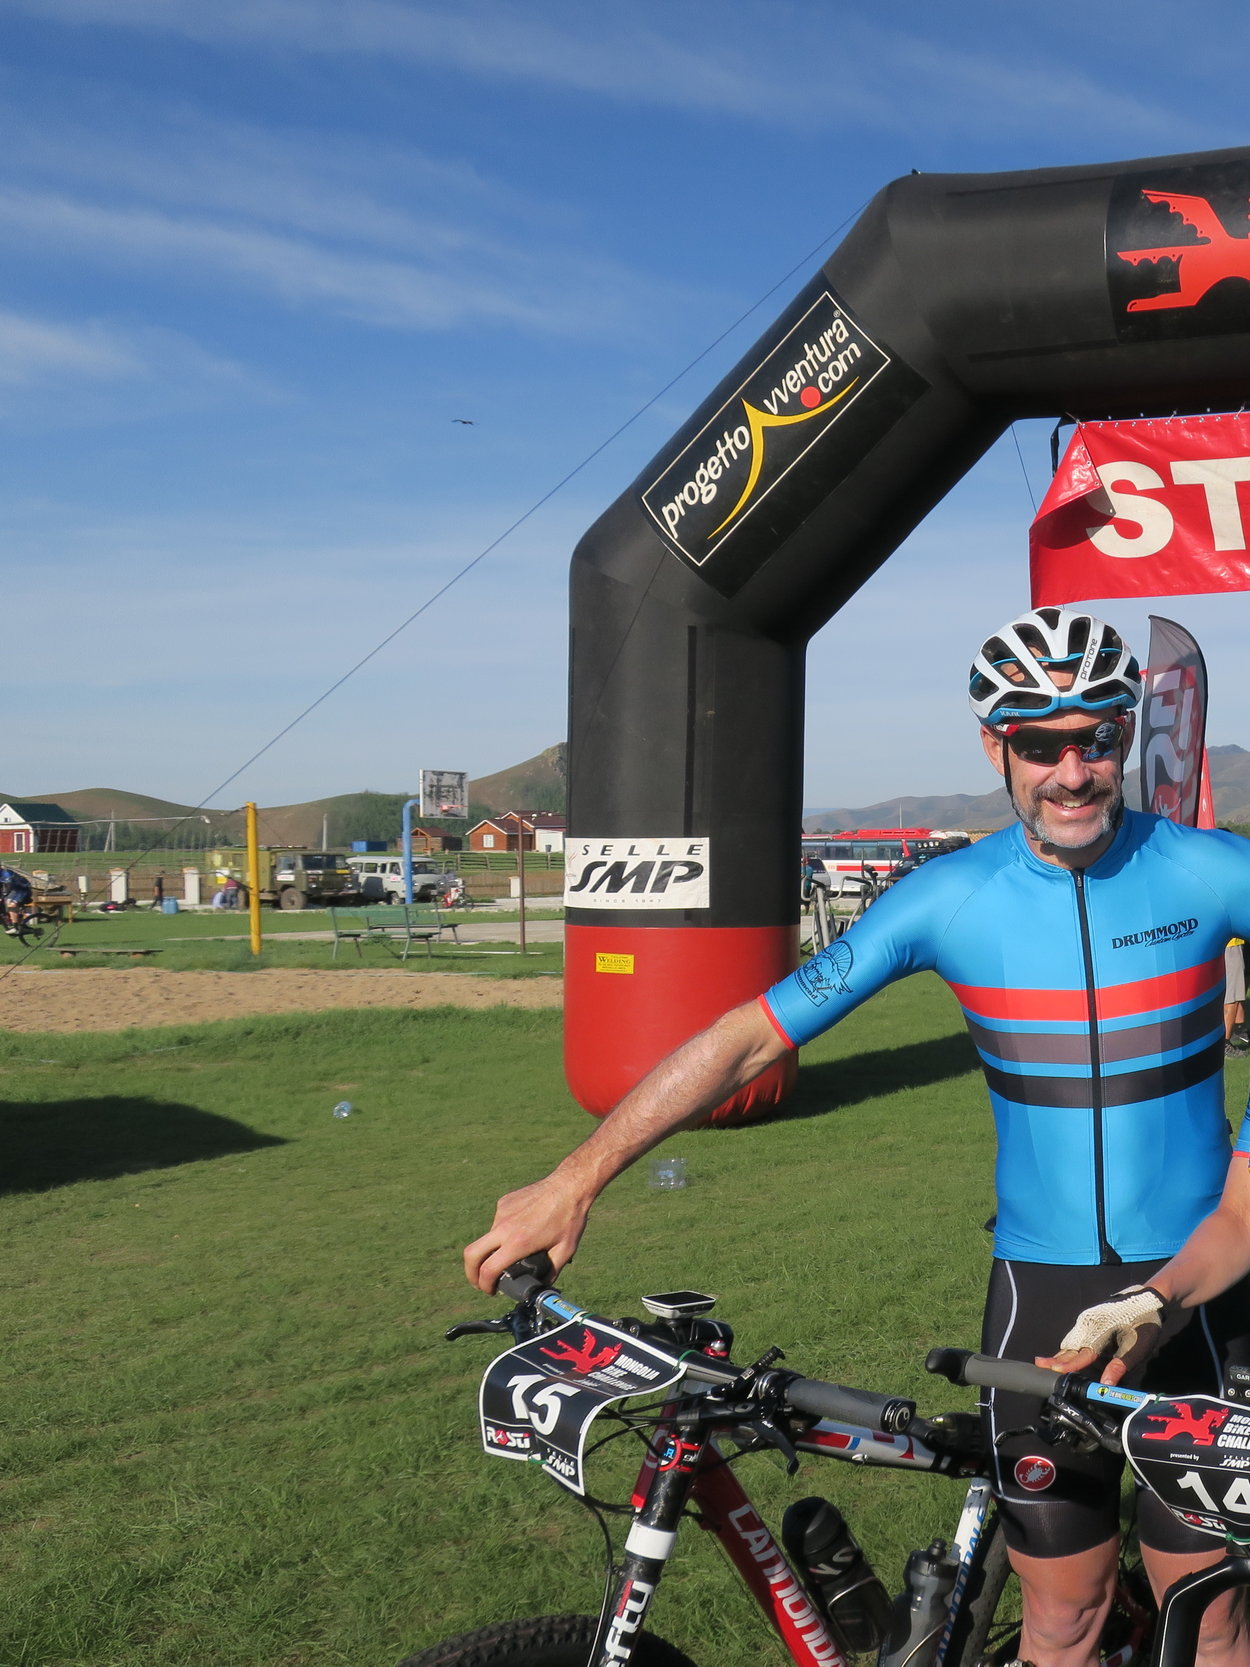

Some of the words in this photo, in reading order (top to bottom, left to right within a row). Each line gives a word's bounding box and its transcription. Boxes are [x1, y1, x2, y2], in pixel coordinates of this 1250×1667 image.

[661, 425, 750, 540] progetto
[581, 844, 704, 856] SELLE
[569, 860, 704, 894] SMP
[1111, 917, 1199, 950] DRUMMOND
[613, 1354, 661, 1381] MONGOLIA
[506, 1374, 581, 1436] 15
[1063, 1405, 1080, 1417] XT
[546, 1455, 576, 1477] SMP
[1169, 1452, 1192, 1460] presented
[1193, 1454, 1200, 1462] by
[1219, 1458, 1250, 1469] SMP
